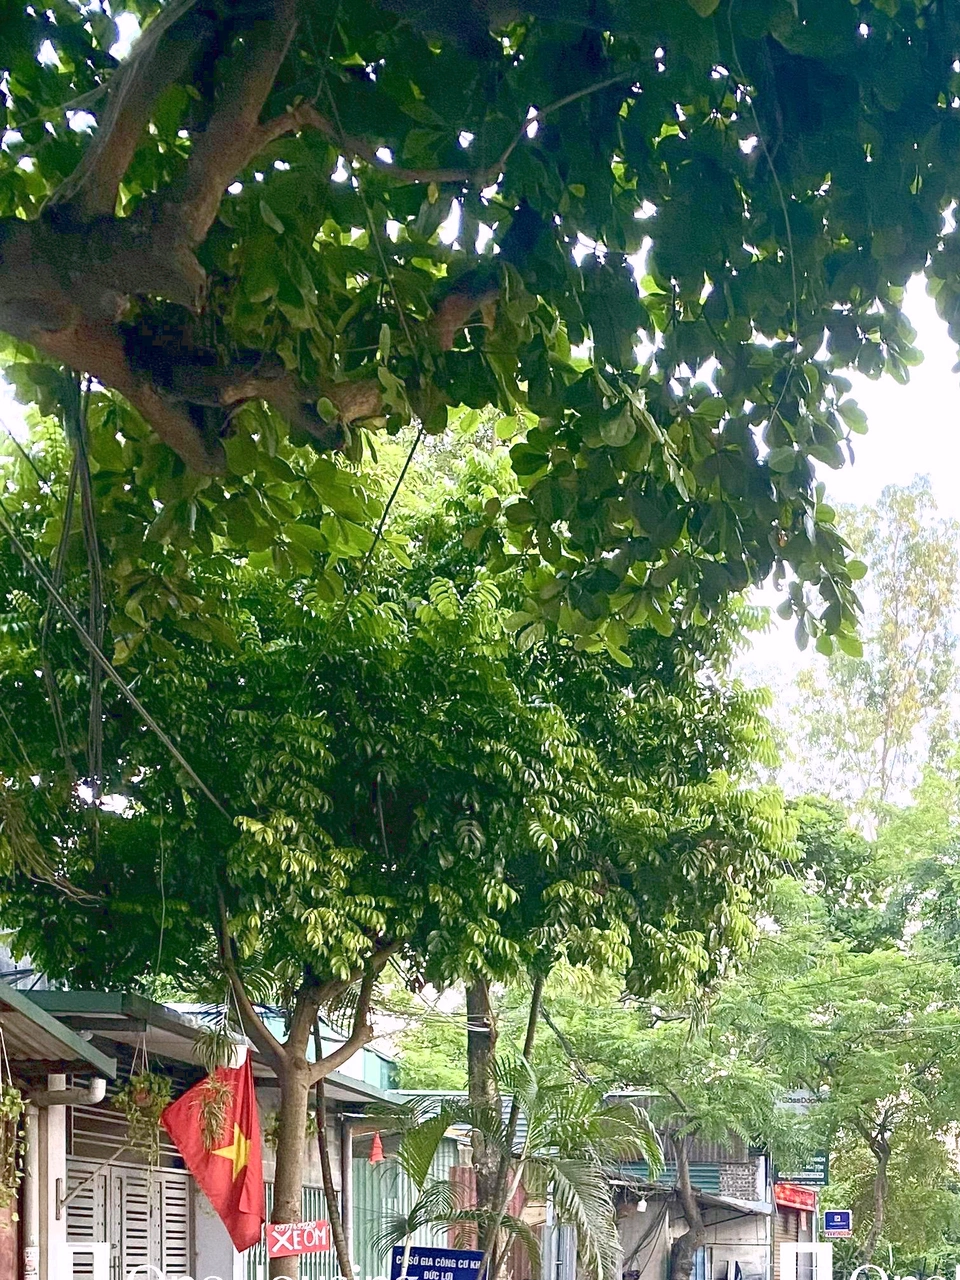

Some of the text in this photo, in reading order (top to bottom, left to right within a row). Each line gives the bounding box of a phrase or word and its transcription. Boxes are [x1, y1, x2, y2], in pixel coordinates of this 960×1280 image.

[420, 1257, 433, 1266] GIA
[435, 1257, 456, 1268] CÔNG
[458, 1259, 469, 1269] CƠ
[470, 1260, 481, 1270] KH
[423, 1270, 439, 1280] ĐỨC
